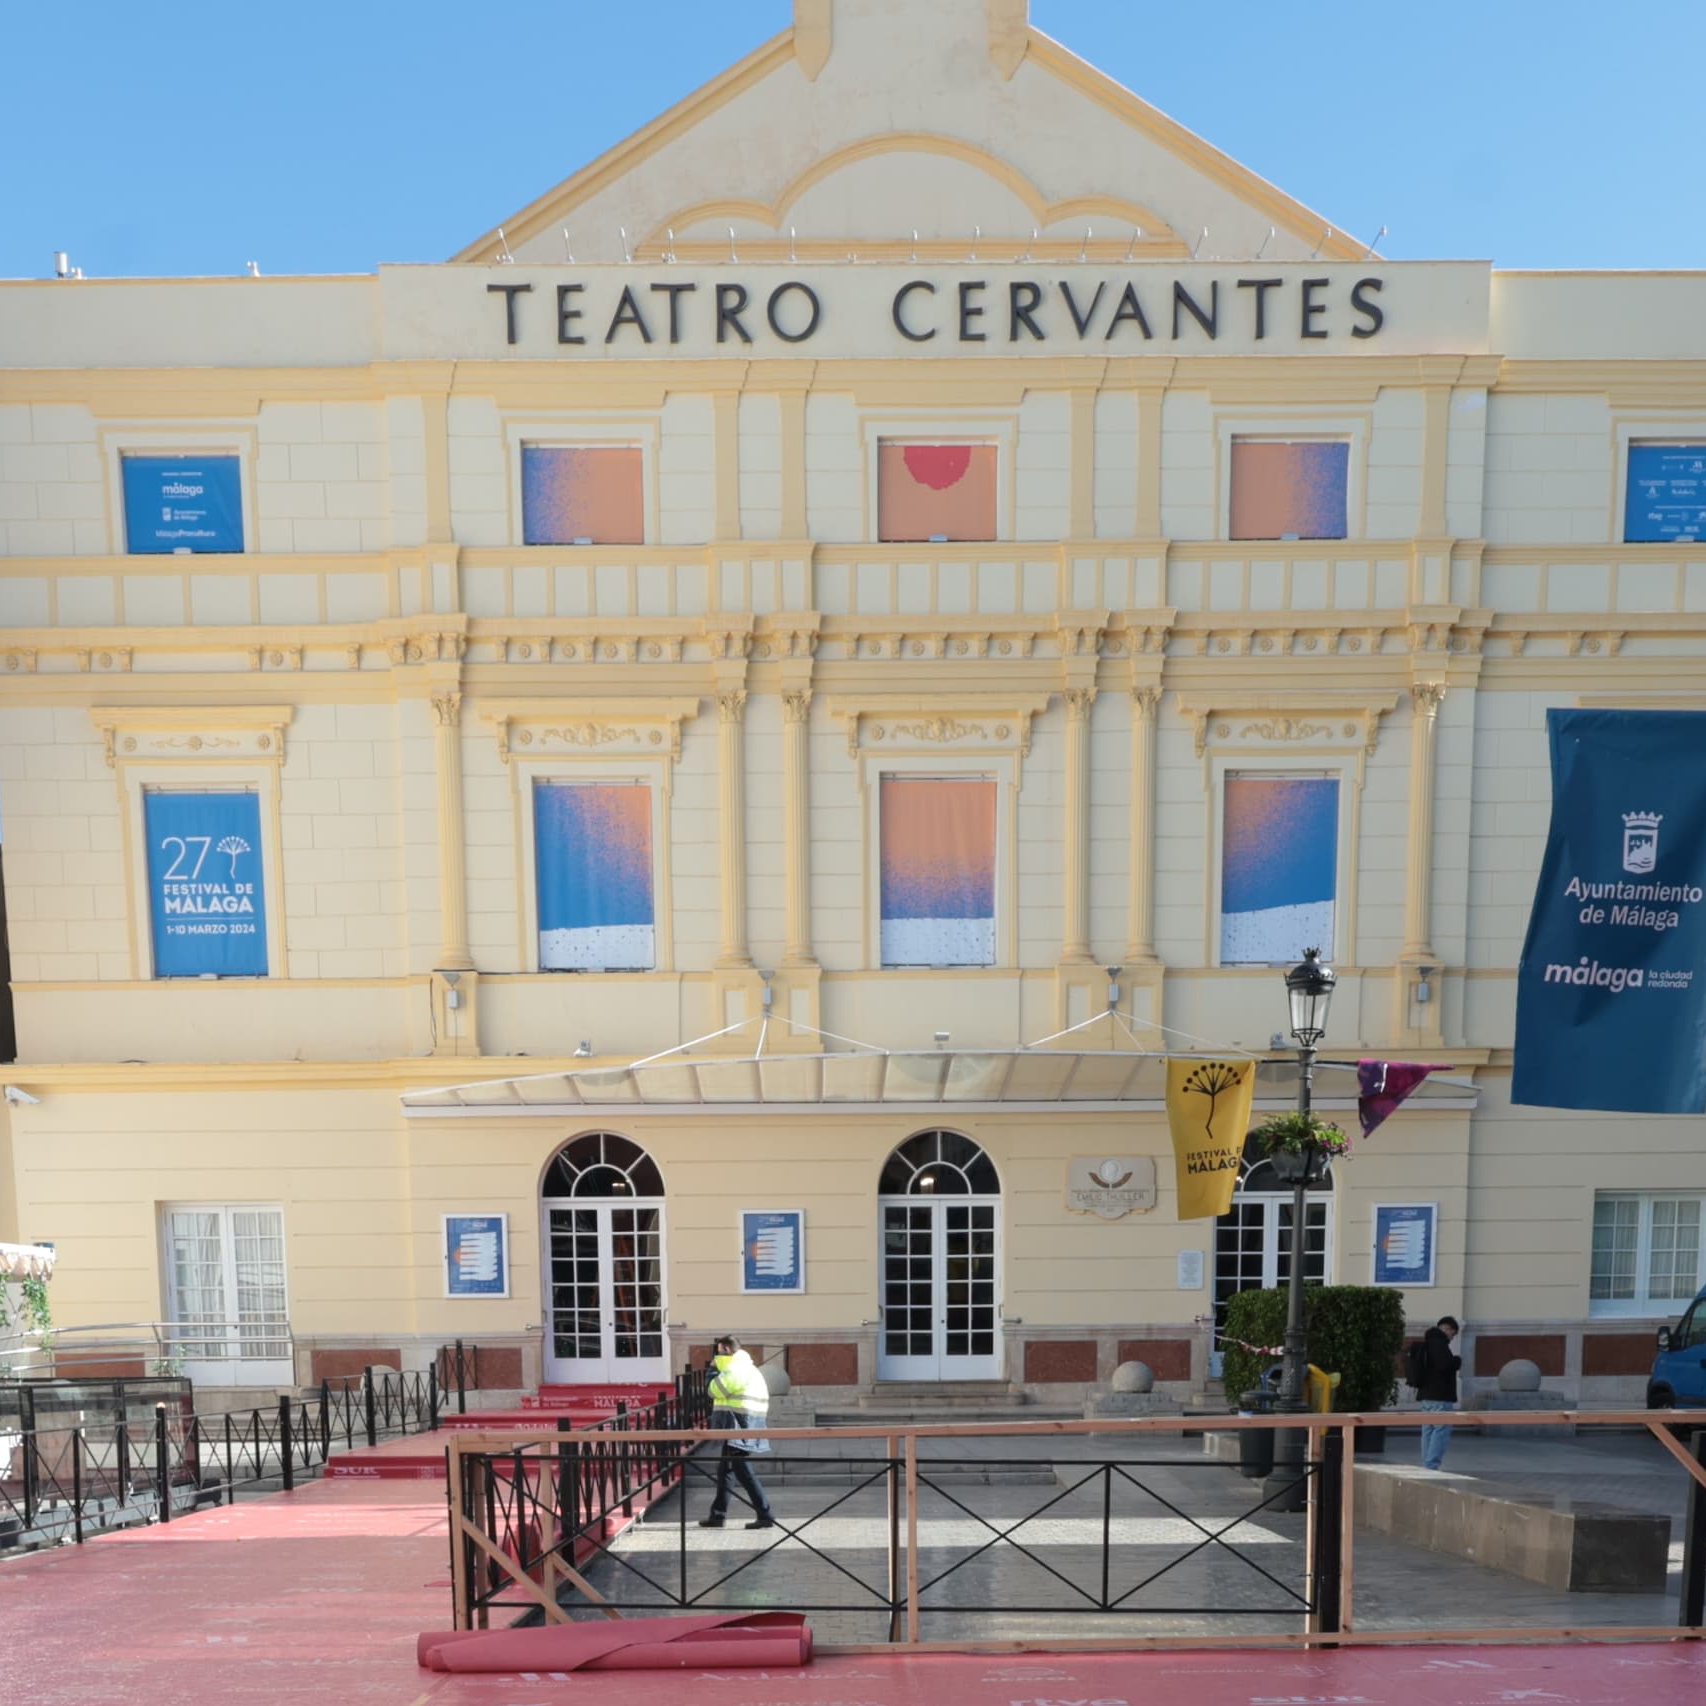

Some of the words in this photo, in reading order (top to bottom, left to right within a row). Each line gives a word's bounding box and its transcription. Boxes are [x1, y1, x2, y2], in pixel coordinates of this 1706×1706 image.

[487, 281, 820, 344] TEATRO
[893, 278, 1385, 342] CERVANTES
[161, 836, 213, 880] 27
[163, 883, 230, 895] FESTIVAL
[235, 882, 254, 894] DE
[1564, 876, 1703, 903] Ayuntamiento
[164, 894, 254, 914] MÁLAGA
[1579, 904, 1605, 924] de
[1610, 905, 1679, 932] Málaga
[166, 924, 186, 935] 1-10
[188, 923, 228, 935] MARZO
[230, 923, 256, 934] 2024
[1648, 979, 1688, 988] redonda
[1660, 970, 1693, 981] ciudad
[1187, 1149, 1232, 1161] FESTIVAL
[1187, 1156, 1241, 1175] MÁLAG
